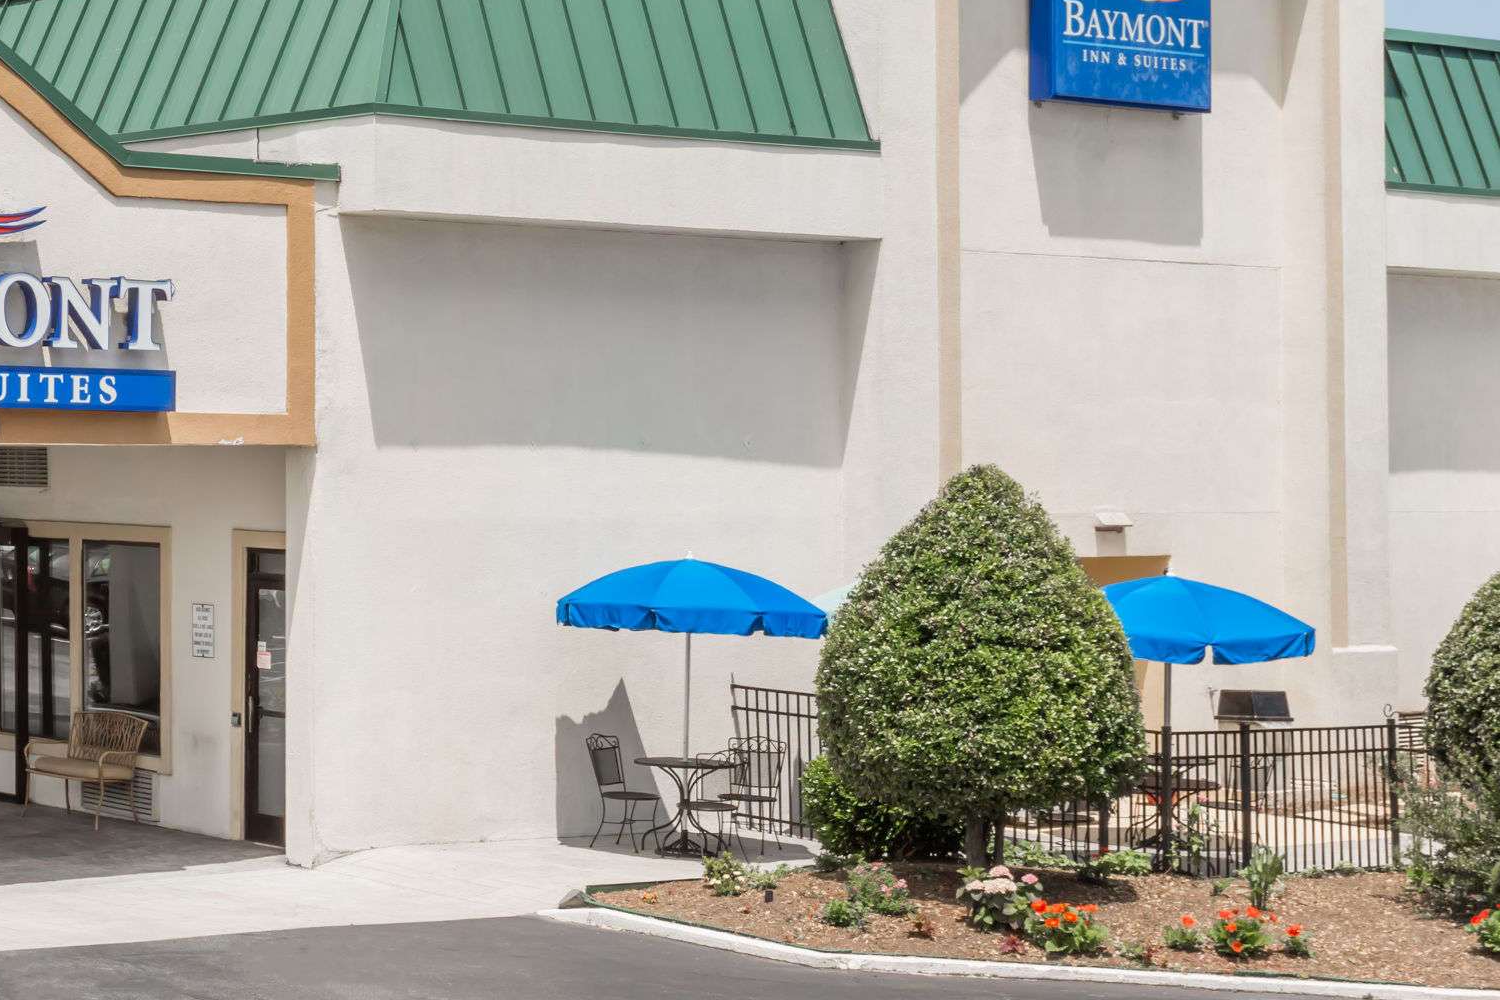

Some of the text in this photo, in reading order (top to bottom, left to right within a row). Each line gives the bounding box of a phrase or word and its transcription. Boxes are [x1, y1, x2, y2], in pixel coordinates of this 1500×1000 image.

[1082, 49, 1187, 71] INN & SUITES
